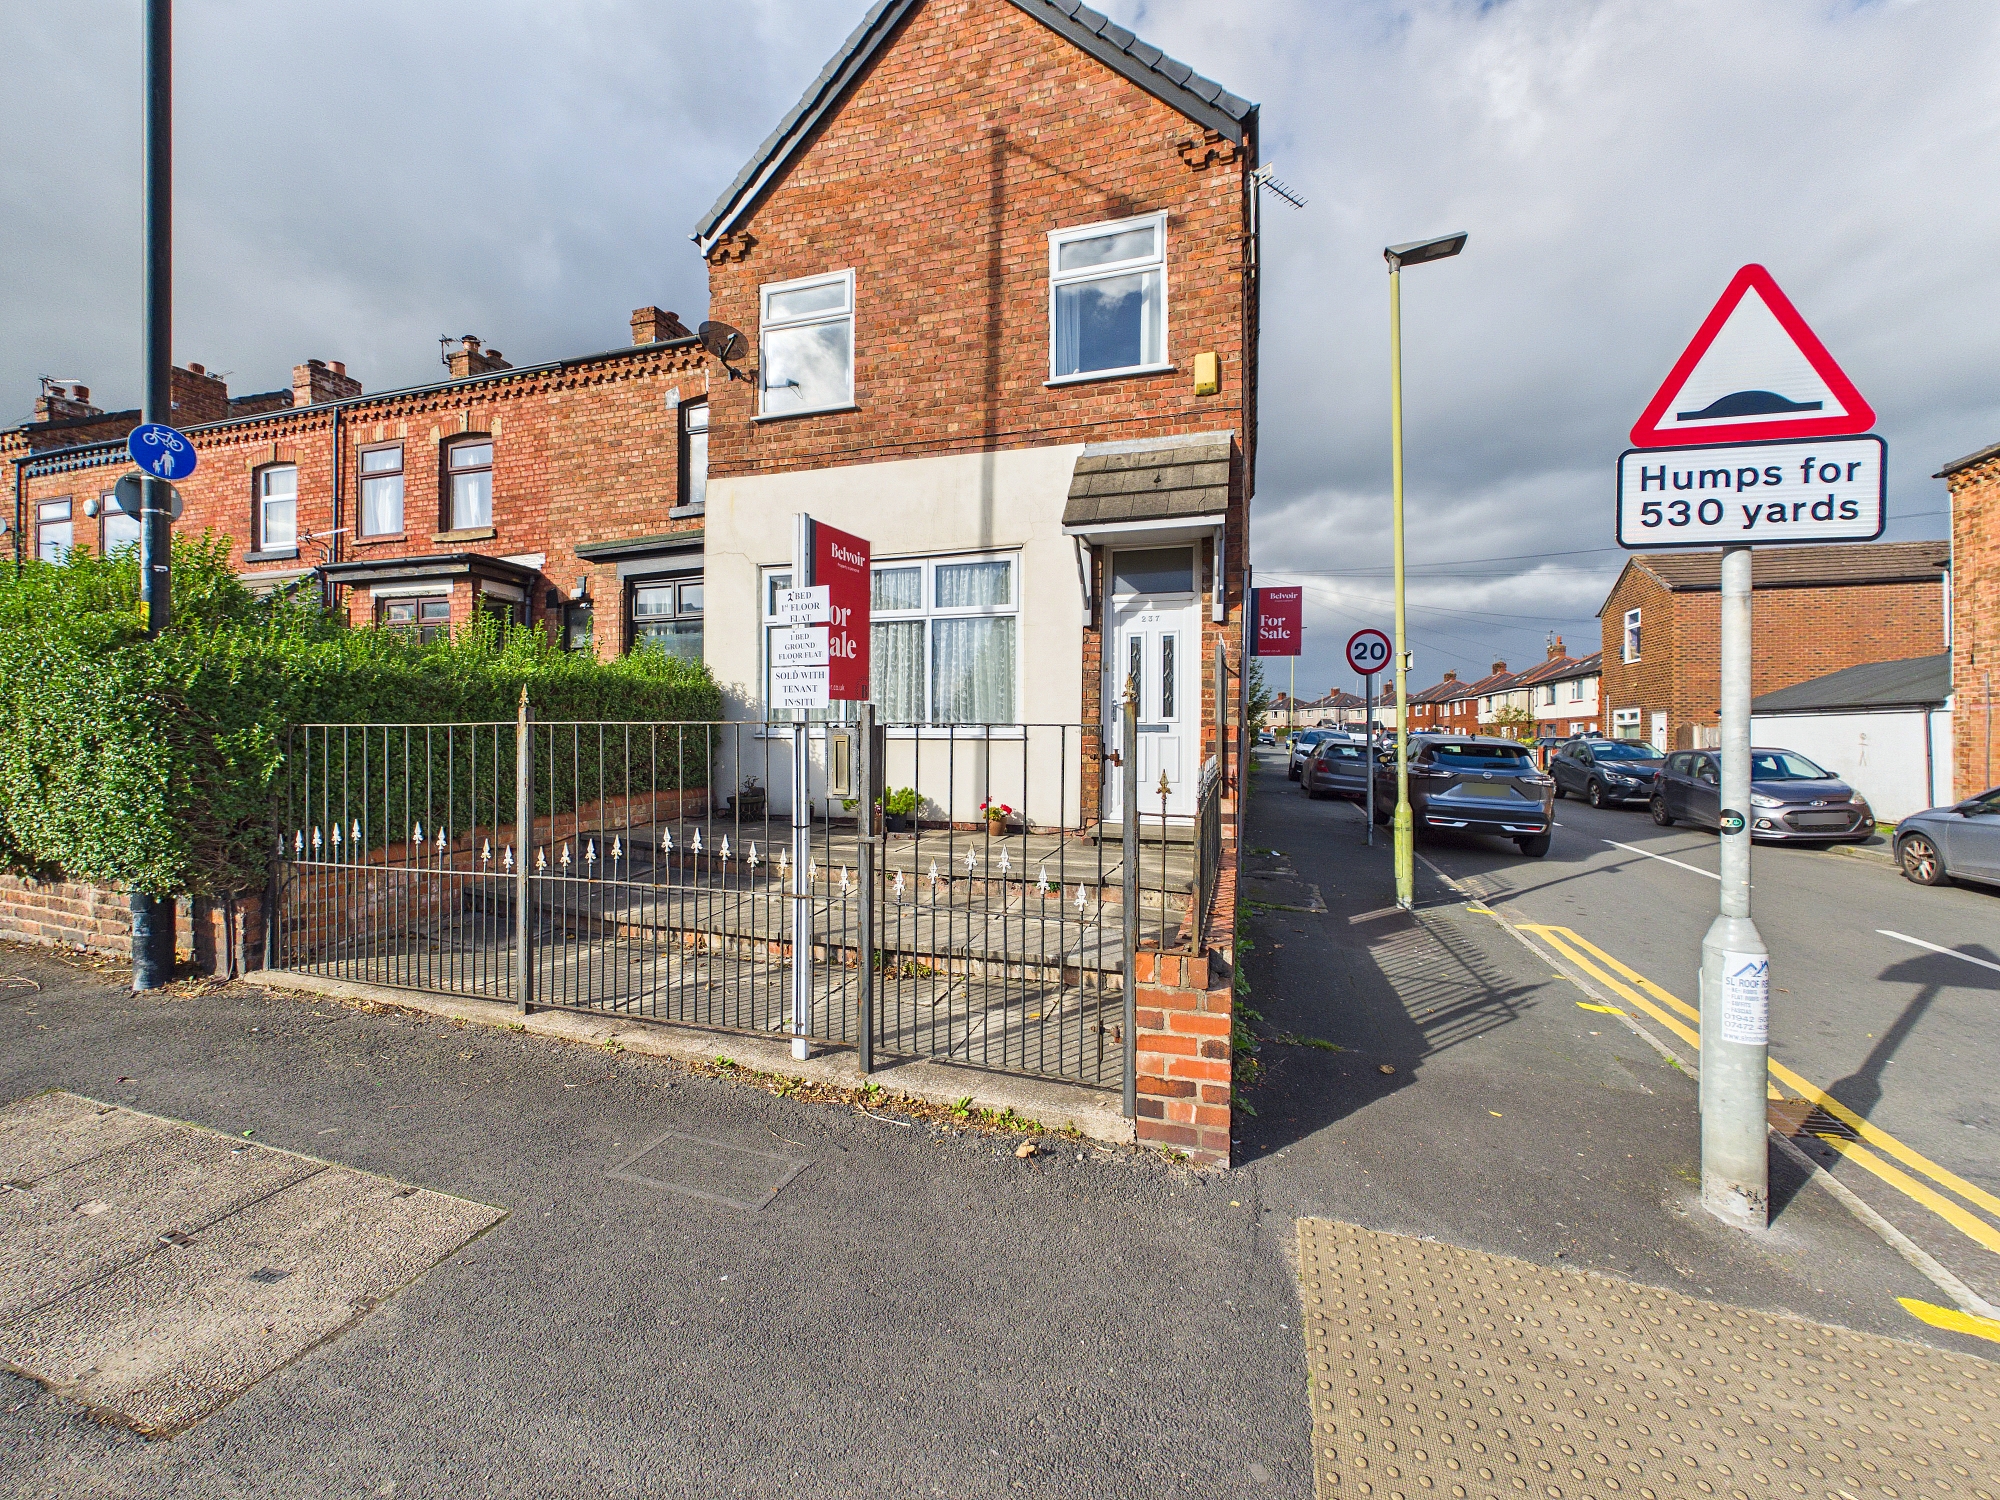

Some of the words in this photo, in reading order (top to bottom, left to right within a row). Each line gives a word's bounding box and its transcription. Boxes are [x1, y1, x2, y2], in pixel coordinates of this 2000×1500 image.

[1640, 464, 1783, 493] Humps
[1800, 456, 1862, 485] for
[1640, 498, 1724, 528] 530
[1742, 493, 1860, 530] yards
[831, 542, 866, 567] Belvoir
[795, 591, 812, 600] BED
[1270, 592, 1298, 600] Belvoir
[790, 602, 820, 611] FLOOR
[790, 614, 812, 623] FLAT
[830, 604, 852, 627] or
[1260, 614, 1286, 627] For
[1259, 627, 1291, 640] Sale
[784, 642, 816, 650] GROUND
[830, 630, 857, 659] ale
[778, 652, 803, 660] FLOOR
[804, 651, 822, 659] FLAT
[1354, 642, 1385, 660] 20
[775, 671, 799, 680] SOLD
[800, 671, 825, 679] WITH
[782, 684, 818, 693] TENANT
[1725, 977, 1735, 986] SL
